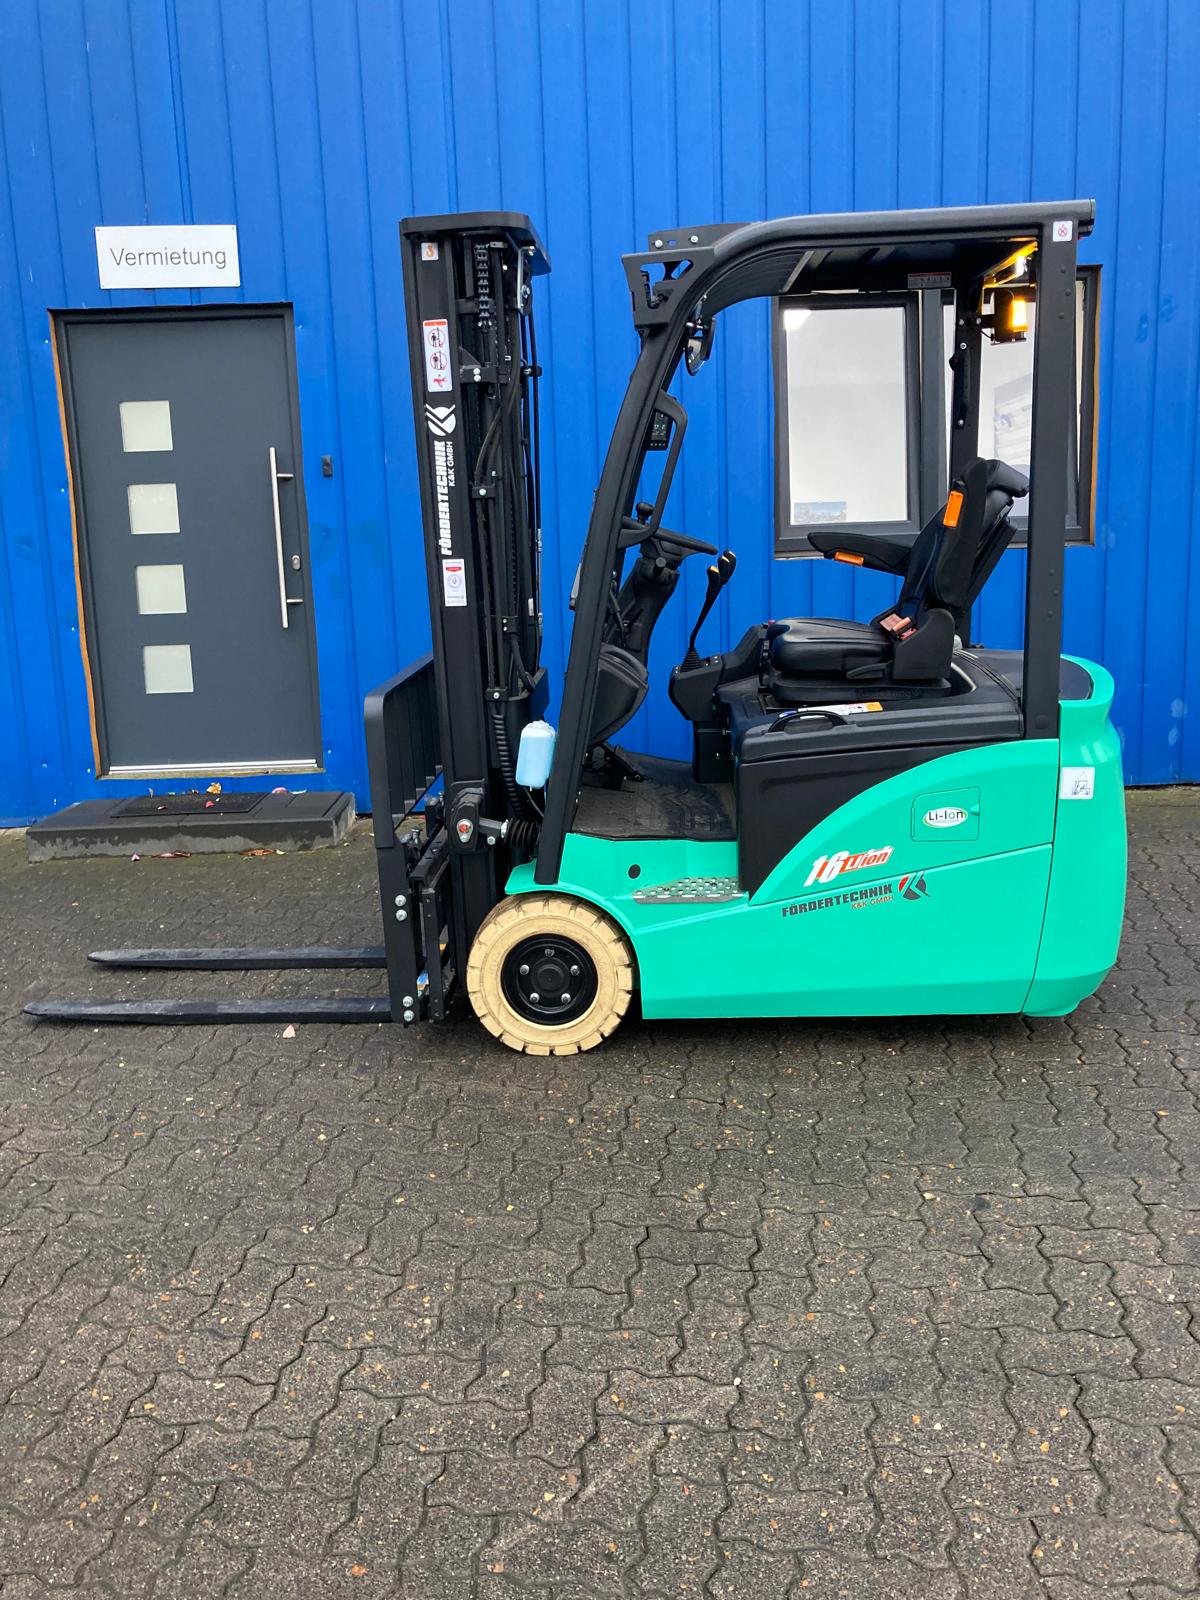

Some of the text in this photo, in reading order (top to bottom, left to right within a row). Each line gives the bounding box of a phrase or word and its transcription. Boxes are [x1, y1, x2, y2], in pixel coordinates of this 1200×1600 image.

[110, 247, 227, 270] Vermietung
[446, 441, 456, 487] K&K GMBH
[434, 440, 452, 556] FÖRDERTECHNIK
[782, 884, 892, 917] FÖRDERTECHNIK
[851, 895, 894, 910] K&K GMBH
